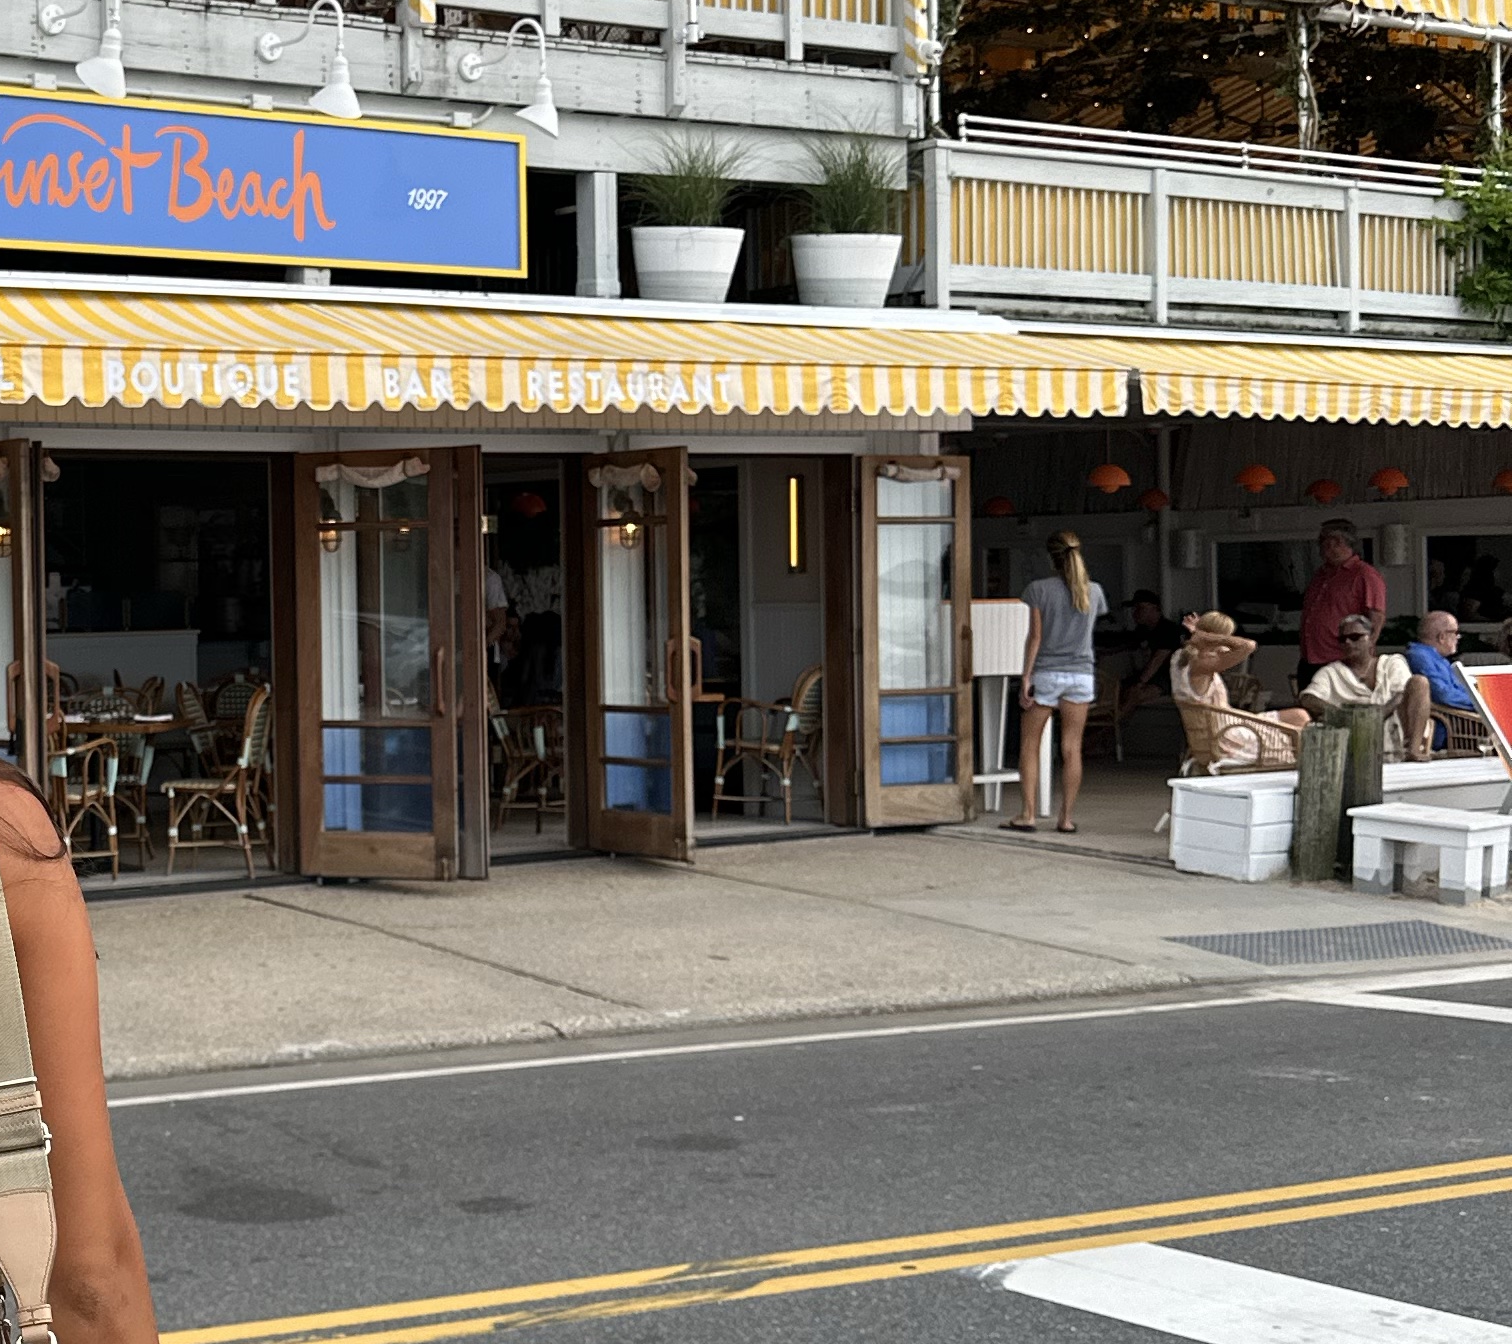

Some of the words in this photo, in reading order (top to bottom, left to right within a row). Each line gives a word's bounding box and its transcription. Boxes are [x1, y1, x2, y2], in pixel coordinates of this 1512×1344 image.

[157, 125, 335, 241] Beach
[407, 188, 449, 211] 1997
[107, 359, 301, 398] BOUTIQUE
[384, 368, 452, 400] BAR
[527, 370, 731, 404] RESTAURANT
